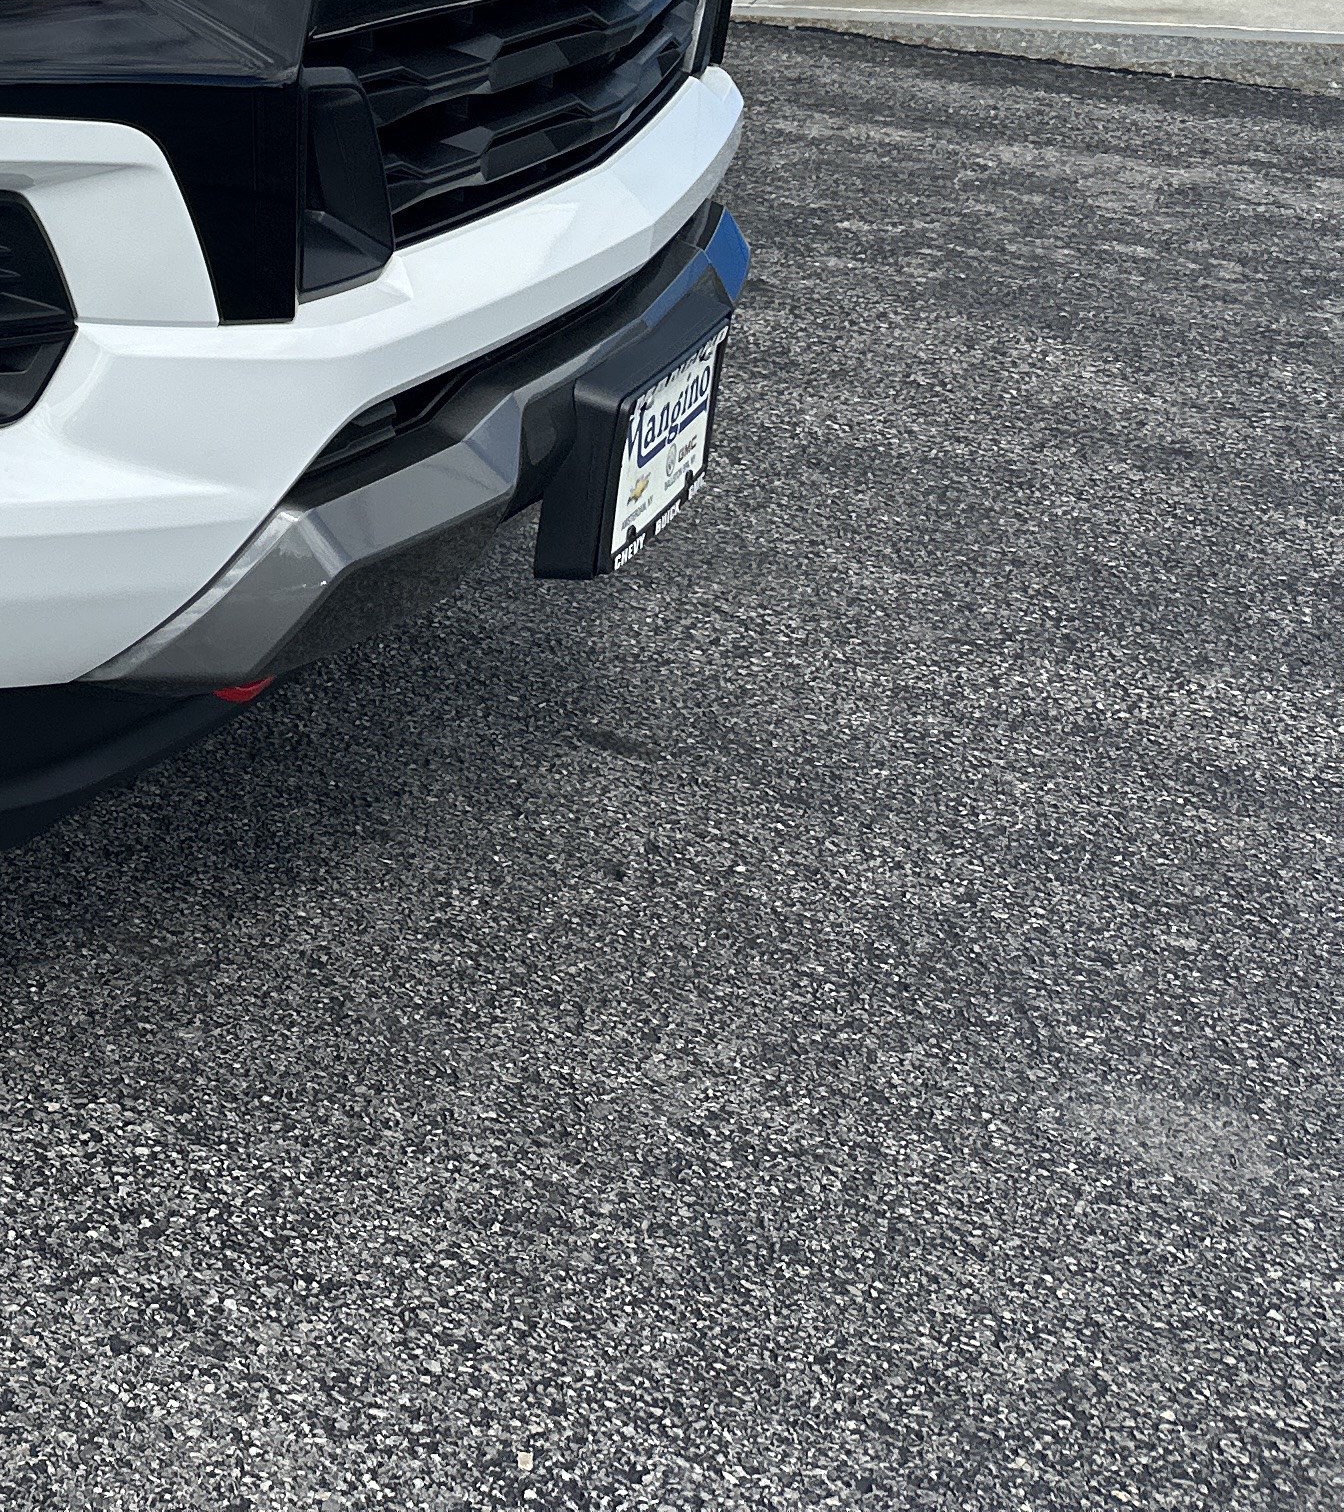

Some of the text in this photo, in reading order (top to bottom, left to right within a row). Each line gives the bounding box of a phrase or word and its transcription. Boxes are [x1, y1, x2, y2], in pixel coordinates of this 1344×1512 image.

[626, 365, 711, 468] Mangino
[614, 533, 646, 571] CHEVY
[655, 499, 682, 536] BUICK
